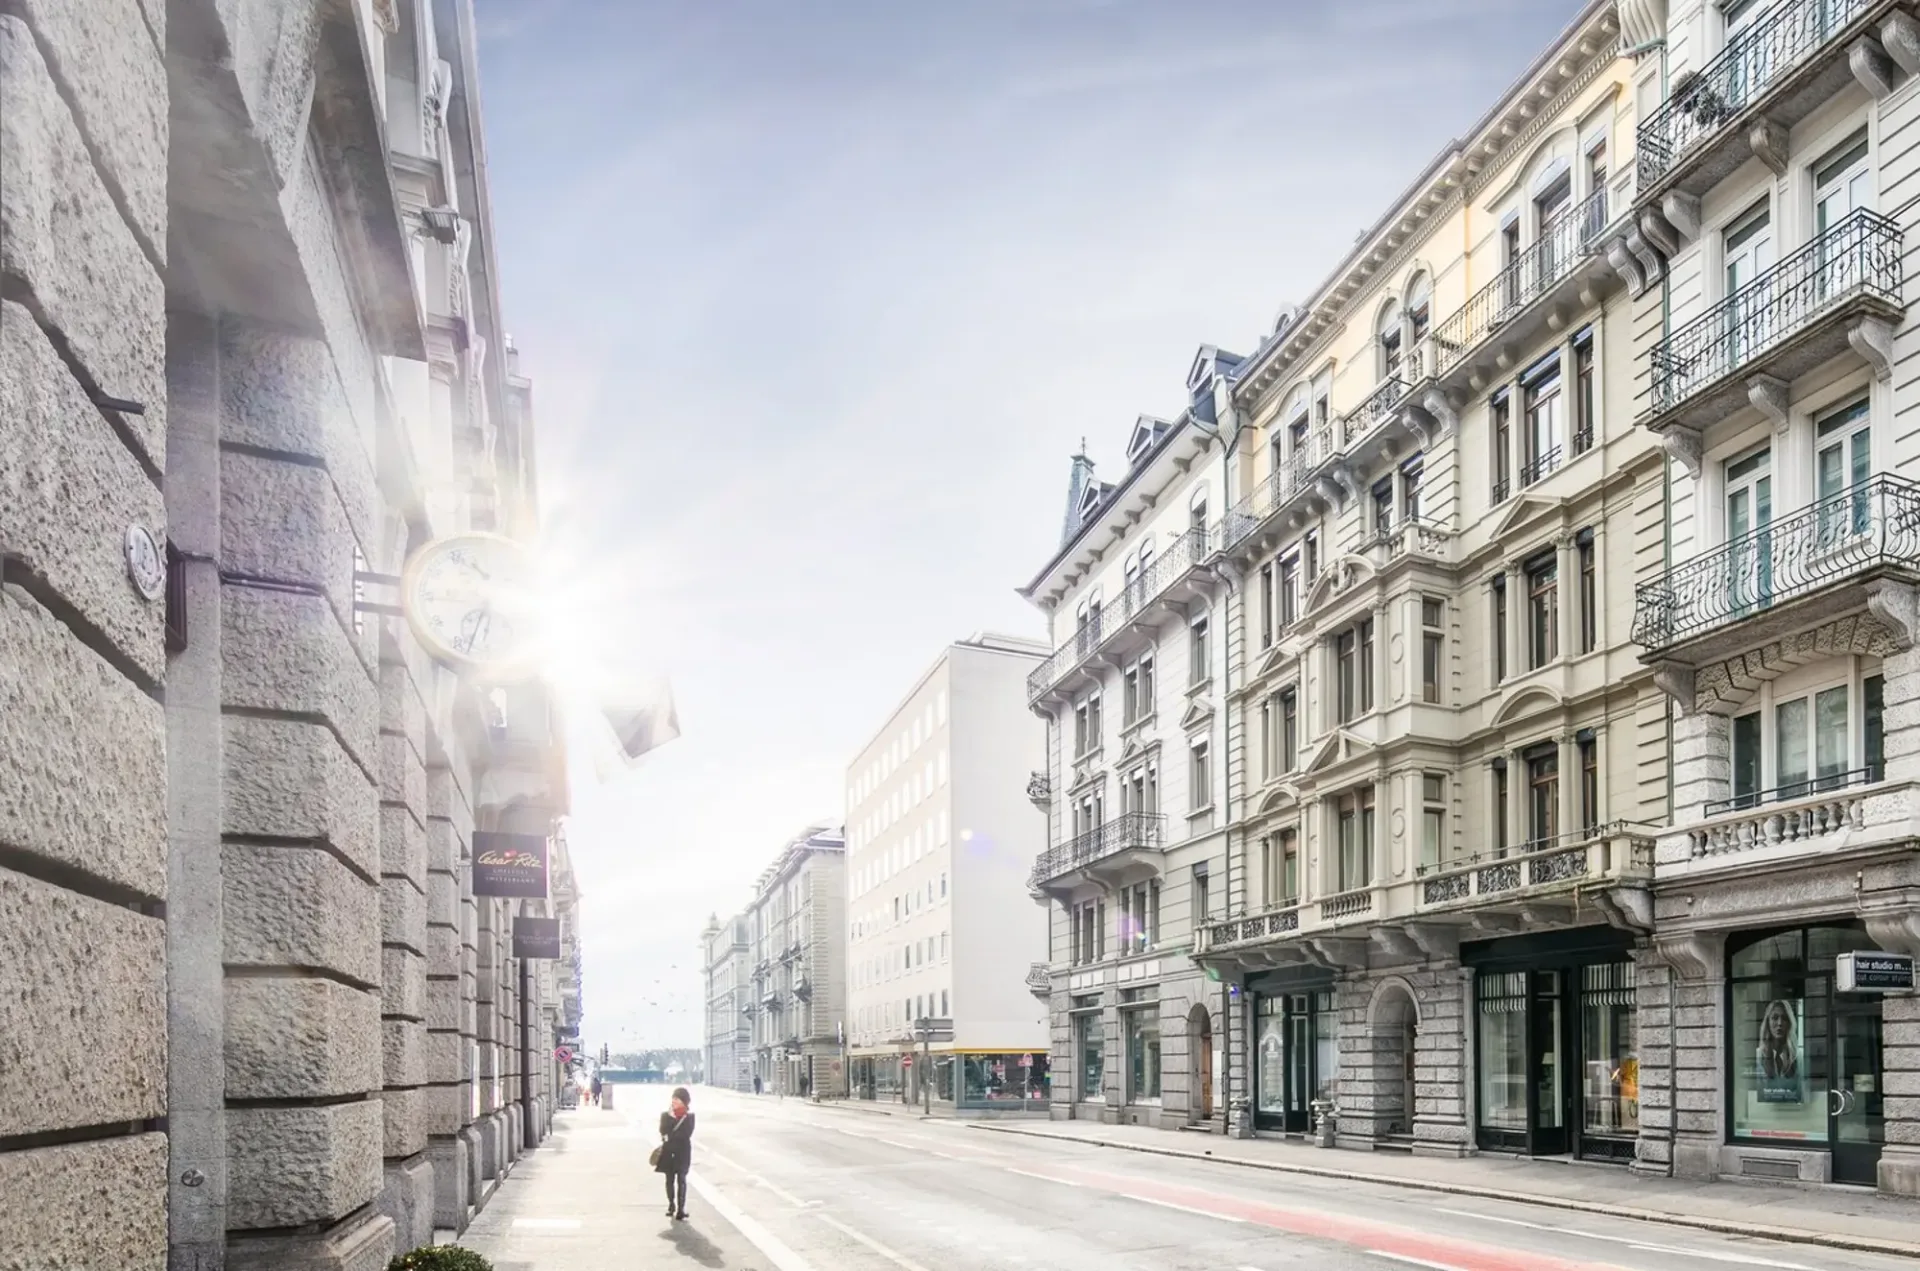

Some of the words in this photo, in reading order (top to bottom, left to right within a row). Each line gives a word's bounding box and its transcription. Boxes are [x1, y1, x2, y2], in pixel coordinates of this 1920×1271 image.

[514, 852, 543, 868] Ritz
[1856, 960, 1870, 969] hair
[1871, 960, 1893, 970] studio
